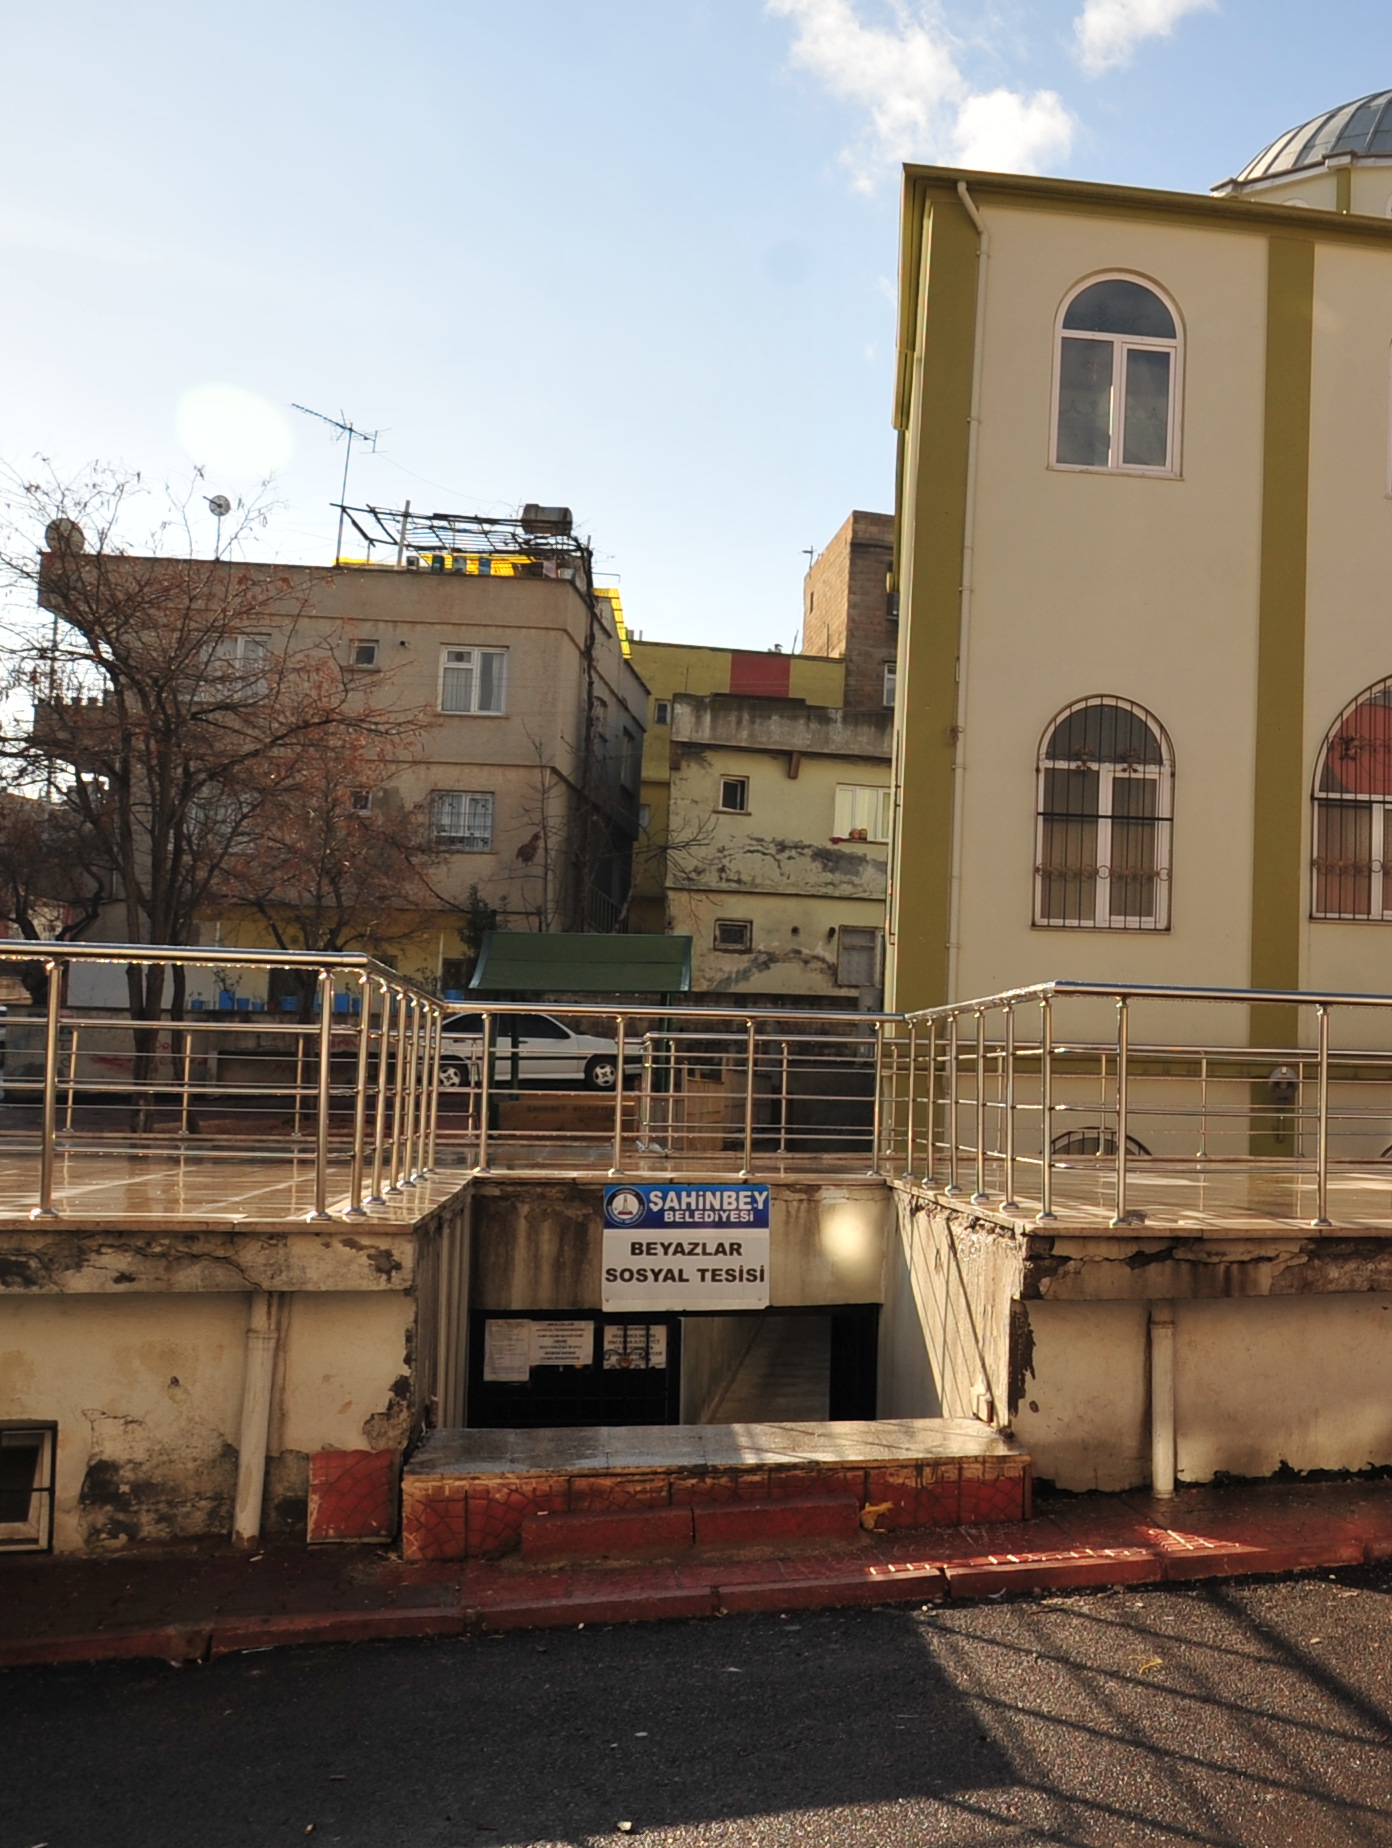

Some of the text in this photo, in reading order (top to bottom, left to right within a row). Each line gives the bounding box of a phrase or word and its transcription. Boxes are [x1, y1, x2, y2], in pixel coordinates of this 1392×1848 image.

[649, 1190, 768, 1212] ŞAHİNBEY
[664, 1210, 754, 1222] BELEDİYESİ
[630, 1241, 743, 1257] BEYAZLAR
[605, 1264, 765, 1283] SOSYAL TESİSİ
